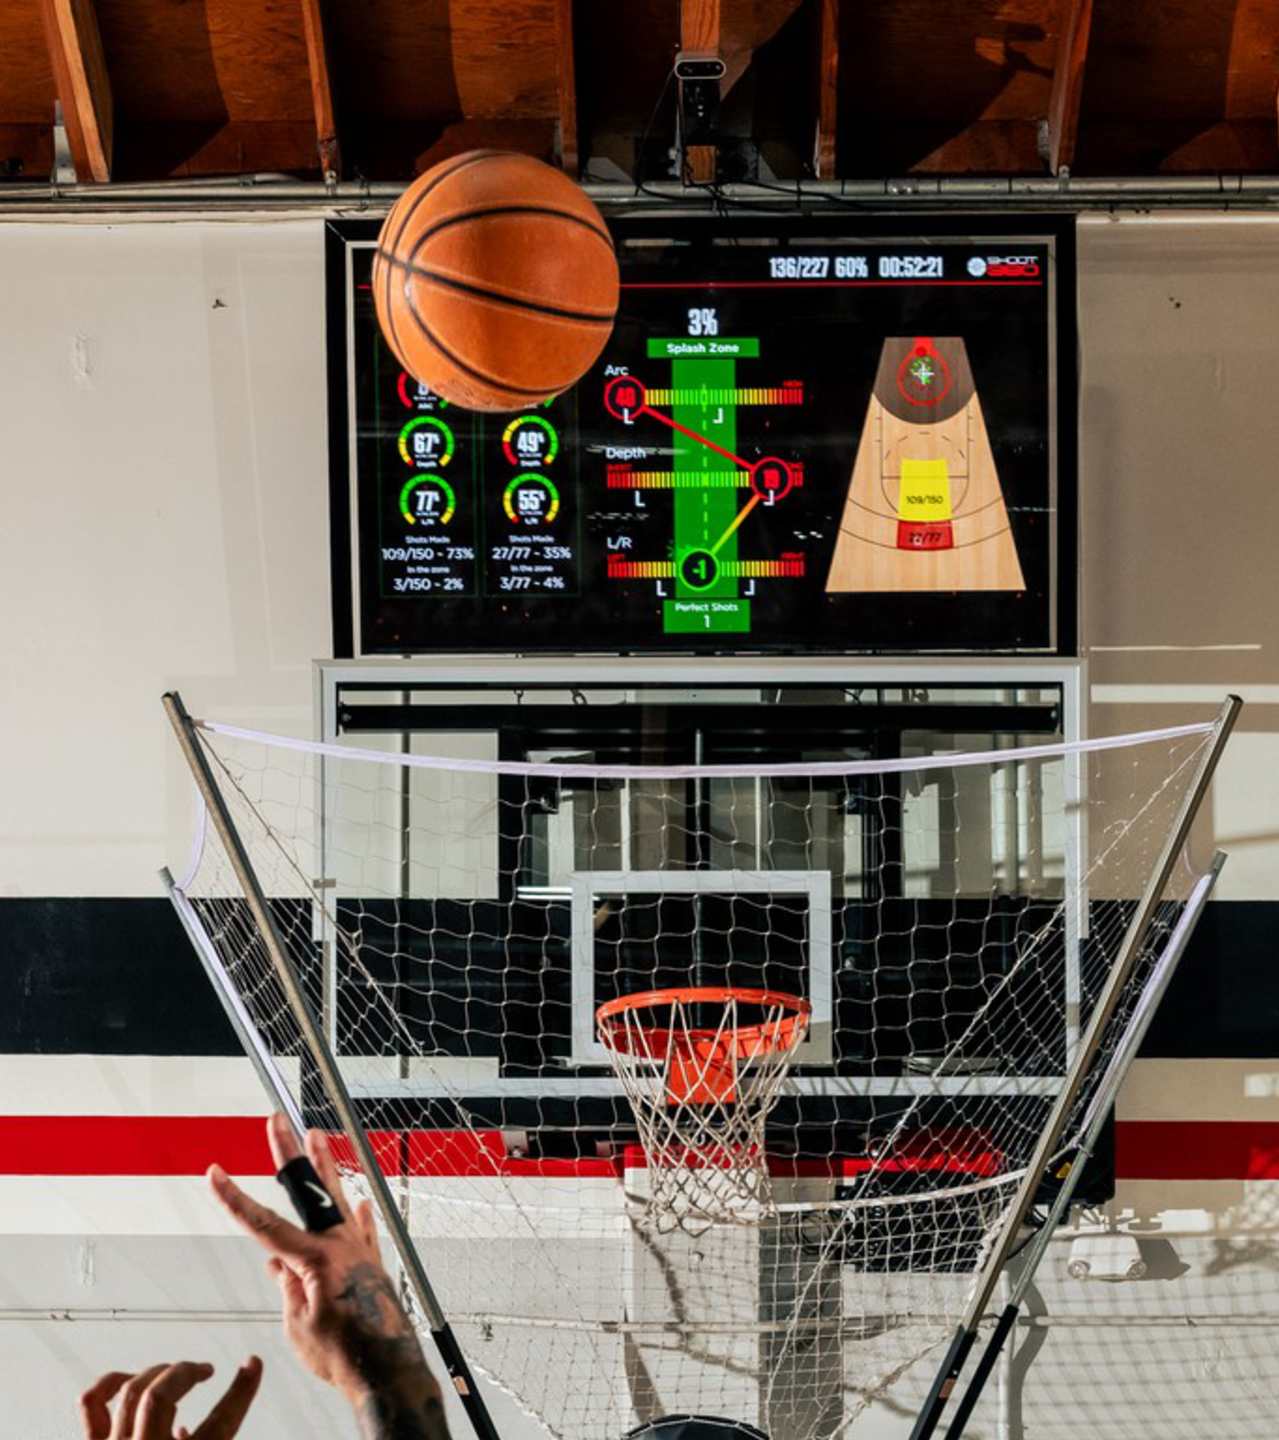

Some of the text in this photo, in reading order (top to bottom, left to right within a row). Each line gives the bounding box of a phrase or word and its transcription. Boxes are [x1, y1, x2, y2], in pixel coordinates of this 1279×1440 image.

[770, 256, 943, 278] 136/227 60% 00:52:21
[987, 256, 1039, 264] SHOOT
[688, 308, 718, 335] 3%
[667, 343, 739, 355] Splash Zone
[604, 364, 629, 376] Arc
[606, 447, 647, 460] Depth
[607, 536, 633, 550] L/R
[381, 547, 435, 562] 109/150
[446, 547, 475, 560] 73%
[492, 546, 531, 561] 27/77
[543, 546, 572, 559] 35%
[393, 577, 431, 592] 3/150
[443, 578, 464, 590] 2%
[500, 576, 531, 591] 3/77
[543, 576, 565, 589] 4%
[675, 603, 738, 612] Perfect Shots
[704, 614, 710, 628] 1
